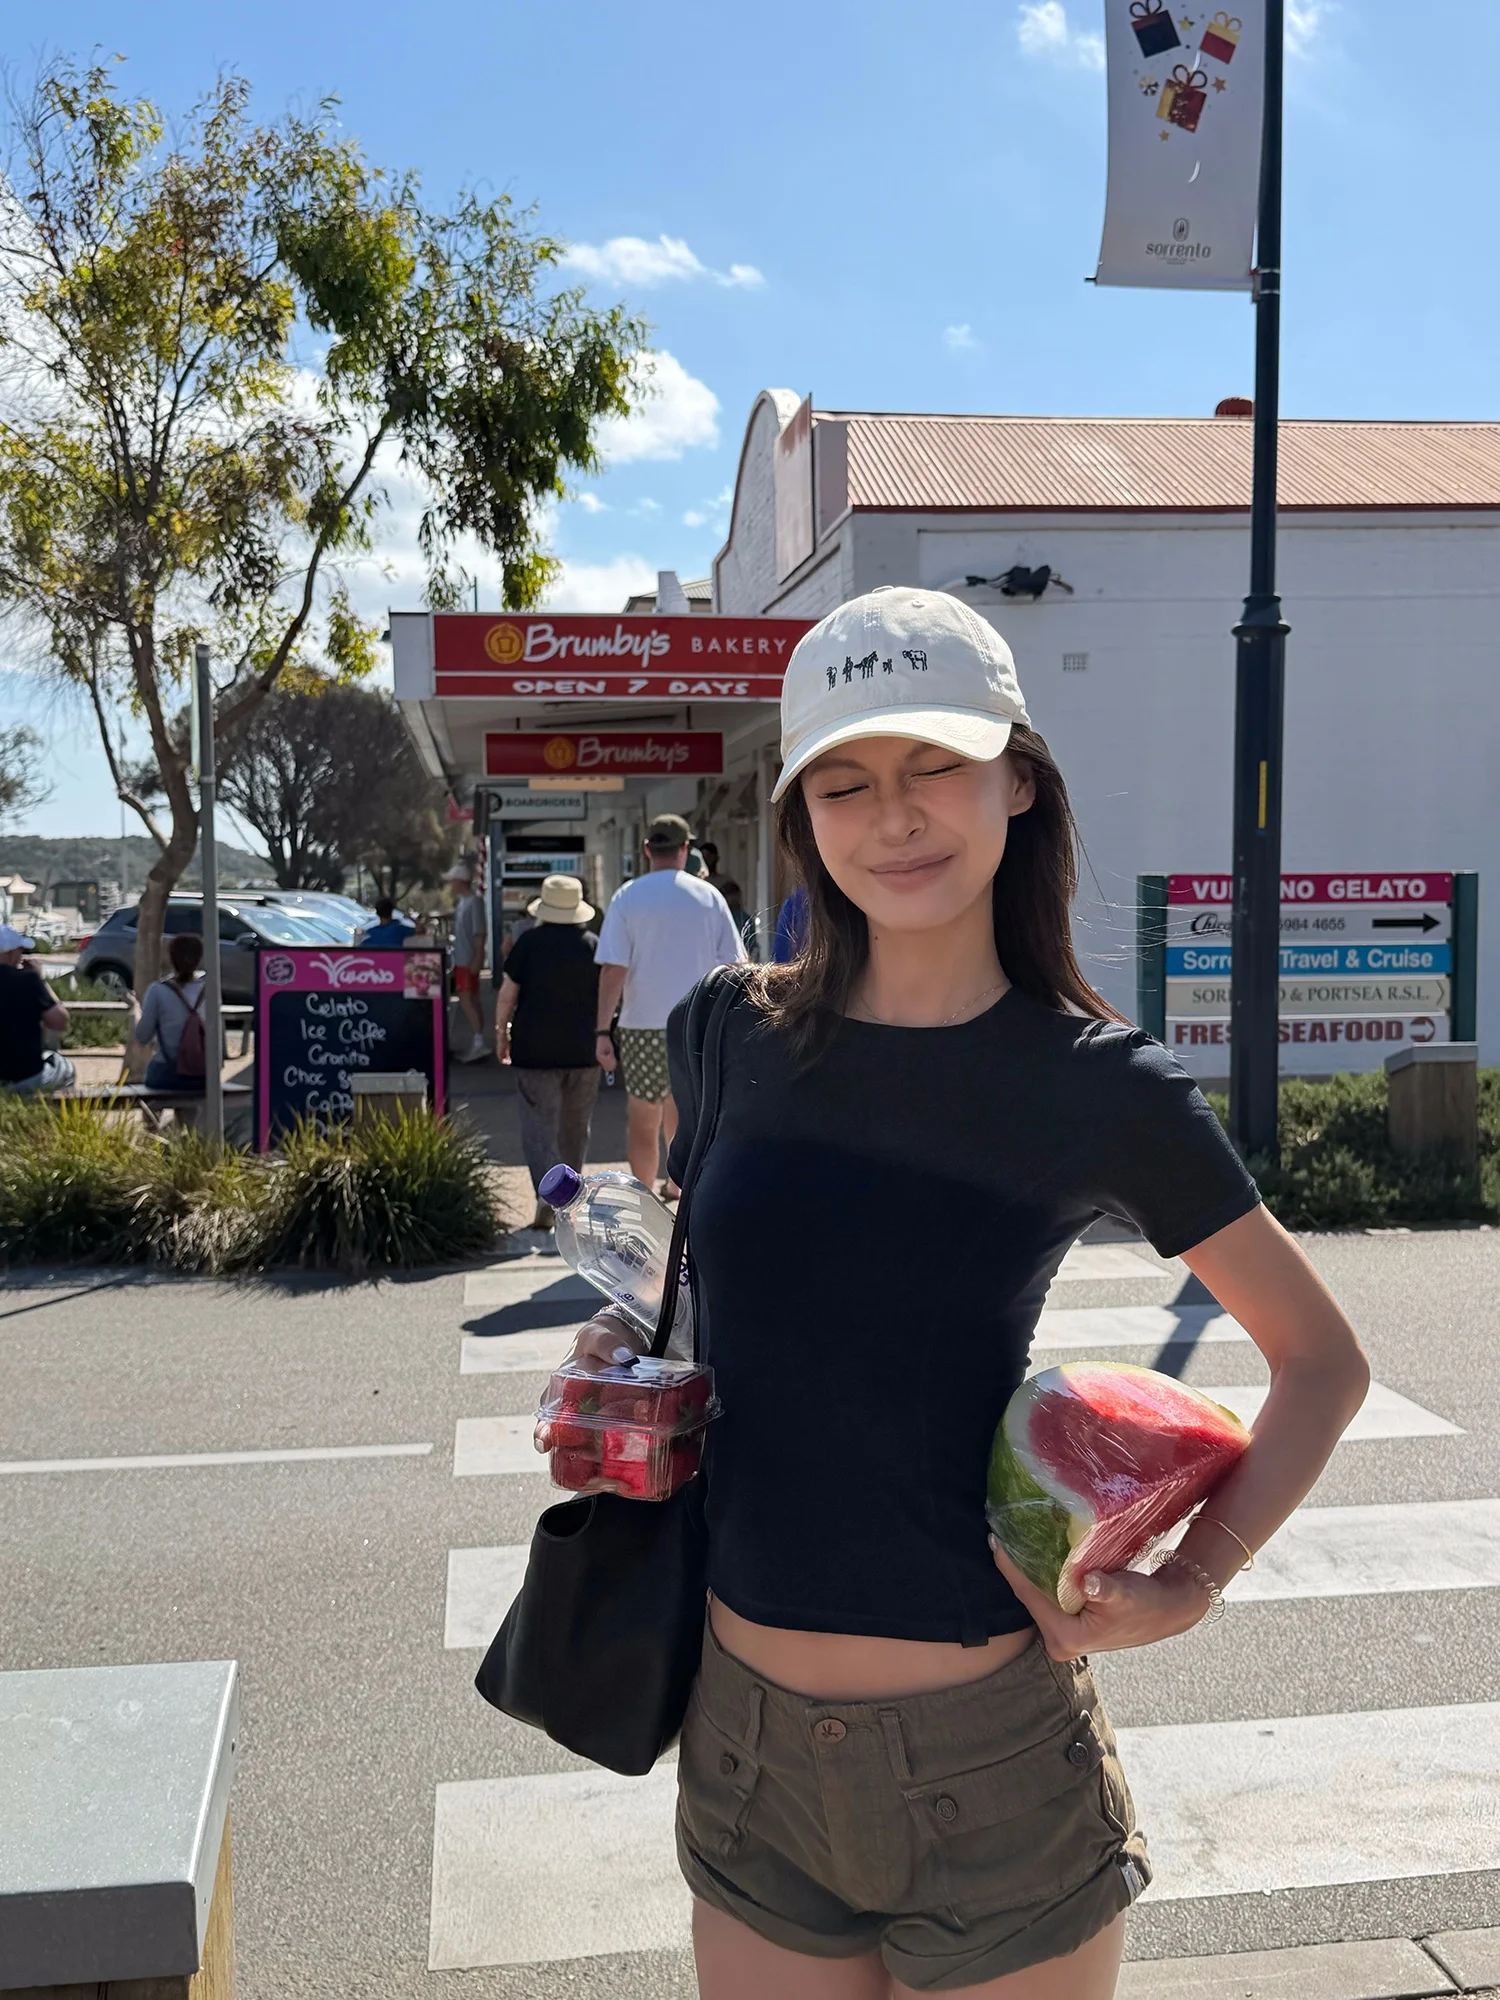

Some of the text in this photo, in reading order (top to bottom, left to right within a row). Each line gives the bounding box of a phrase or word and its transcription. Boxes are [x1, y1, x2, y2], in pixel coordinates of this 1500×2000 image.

[1145, 242, 1212, 258] sorrento
[523, 622, 788, 668] Brumby's BAKERY
[512, 679, 750, 696] OPEN 7 DAYS
[576, 736, 690, 772] Brumby's
[1191, 878, 1427, 901] VUNO GELATO
[1279, 949, 1338, 969] Travel
[1345, 949, 1360, 969] &
[1366, 947, 1434, 969] Cruise
[1290, 987, 1303, 1002] &
[1307, 984, 1383, 1002] PORTSEA
[1387, 983, 1431, 1001] R.S.L.
[300, 1018, 387, 1052] Ice Coffee
[1278, 1020, 1404, 1044] SEAFOOD
[283, 1065, 327, 1088] Choc
